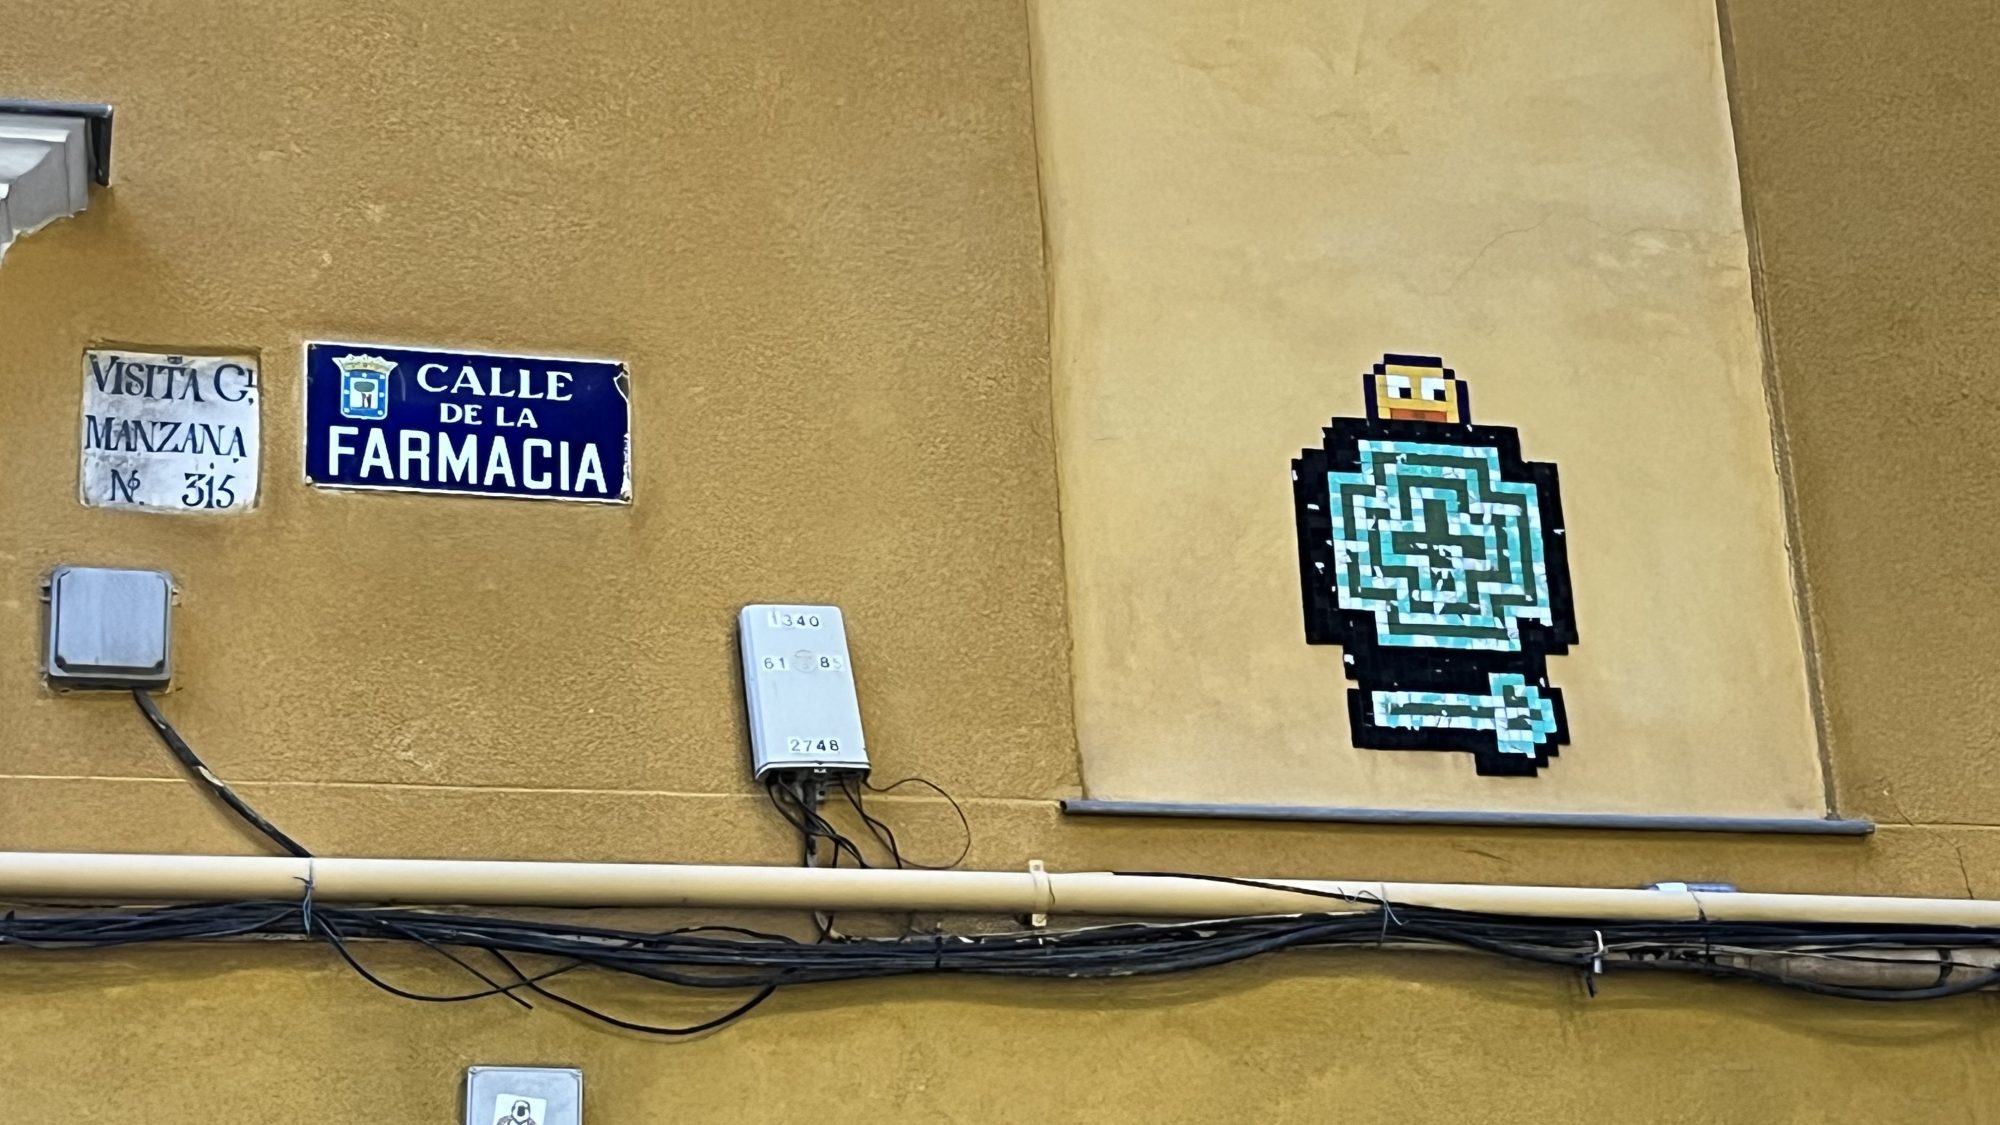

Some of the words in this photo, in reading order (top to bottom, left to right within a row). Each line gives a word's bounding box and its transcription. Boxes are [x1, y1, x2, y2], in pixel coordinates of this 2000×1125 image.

[89, 354, 205, 402] VISITA
[416, 363, 573, 401] CALLE
[440, 403, 483, 425] DE
[496, 406, 538, 429] LA
[328, 425, 608, 494] FARMACIA
[764, 657, 786, 670] 61
[790, 739, 839, 752] 2748
